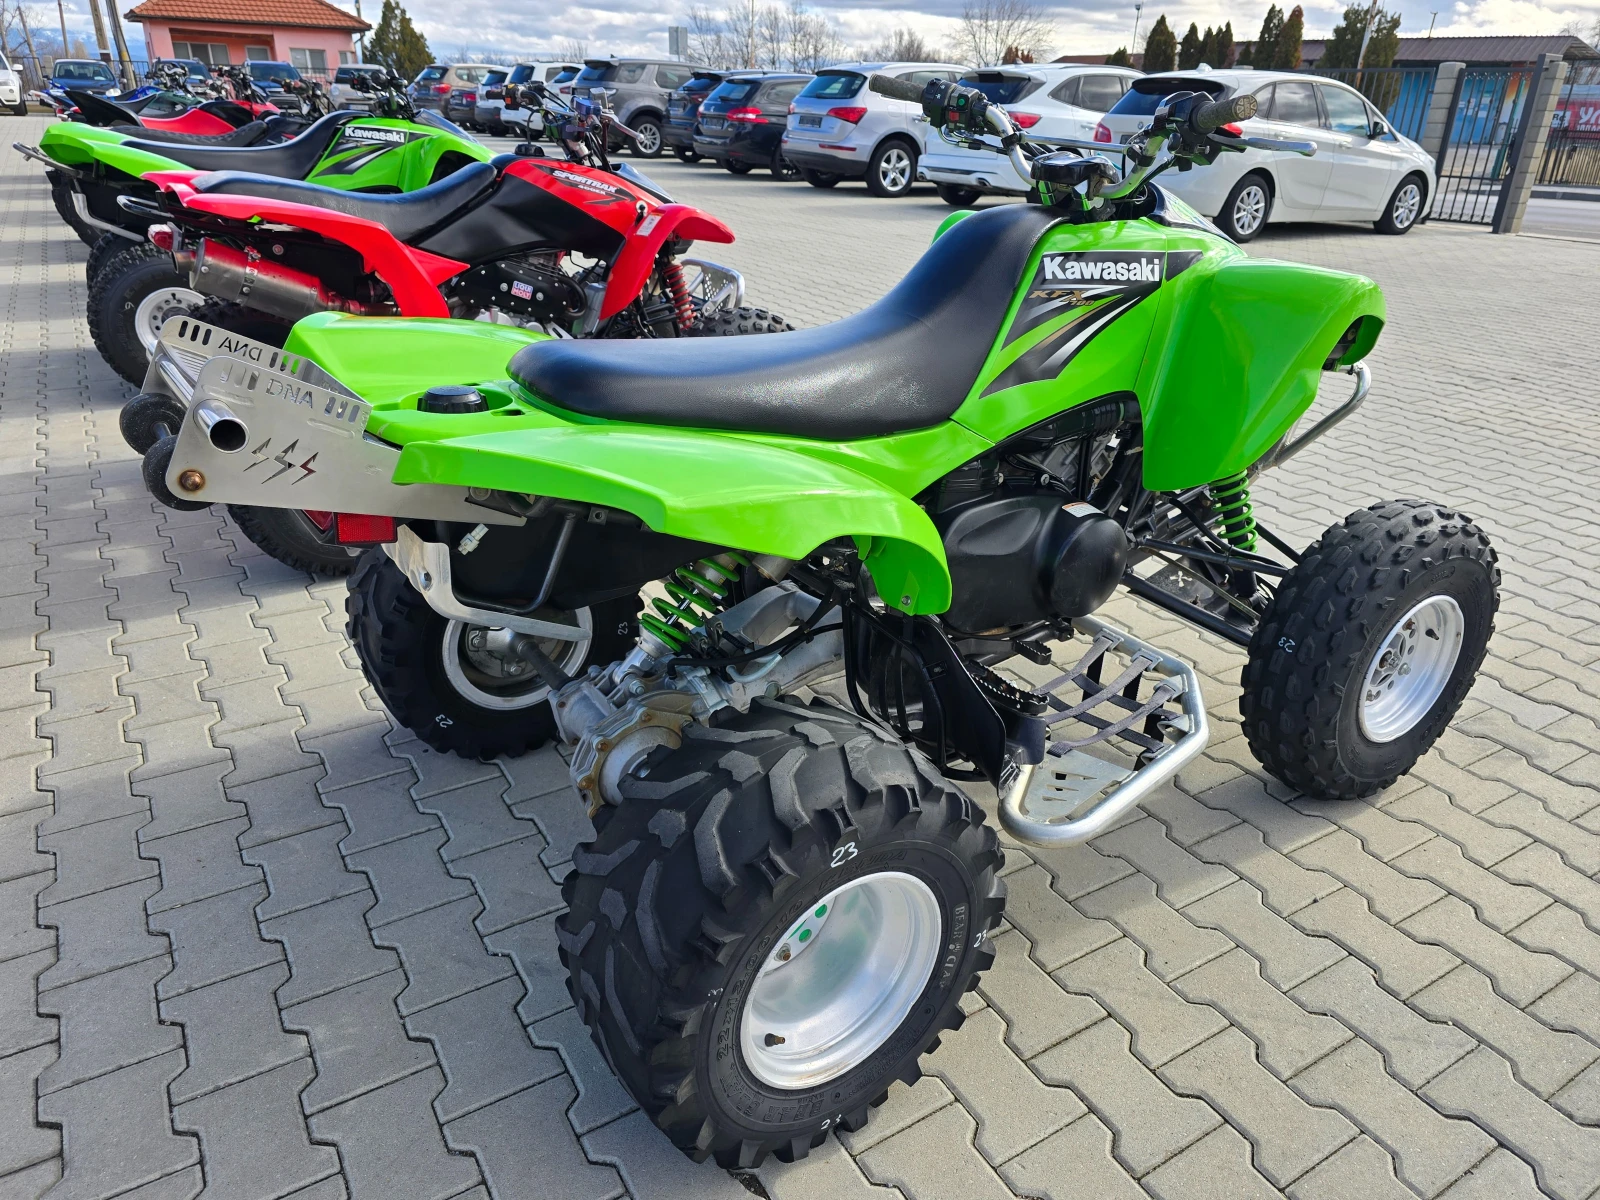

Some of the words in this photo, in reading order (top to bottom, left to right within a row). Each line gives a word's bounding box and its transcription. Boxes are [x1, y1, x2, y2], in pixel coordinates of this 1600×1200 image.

[344, 127, 405, 143] Kawasaki
[552, 170, 617, 193] SPORTRAX
[1043, 256, 1160, 282] Kawasaki
[1029, 290, 1087, 304] KFX
[265, 378, 314, 409] DNA
[617, 621, 629, 636] 23
[1277, 636, 1296, 653] 23
[434, 713, 454, 729] 23
[830, 841, 859, 868] 23
[953, 905, 966, 944] BEAR
[973, 928, 987, 949] 23
